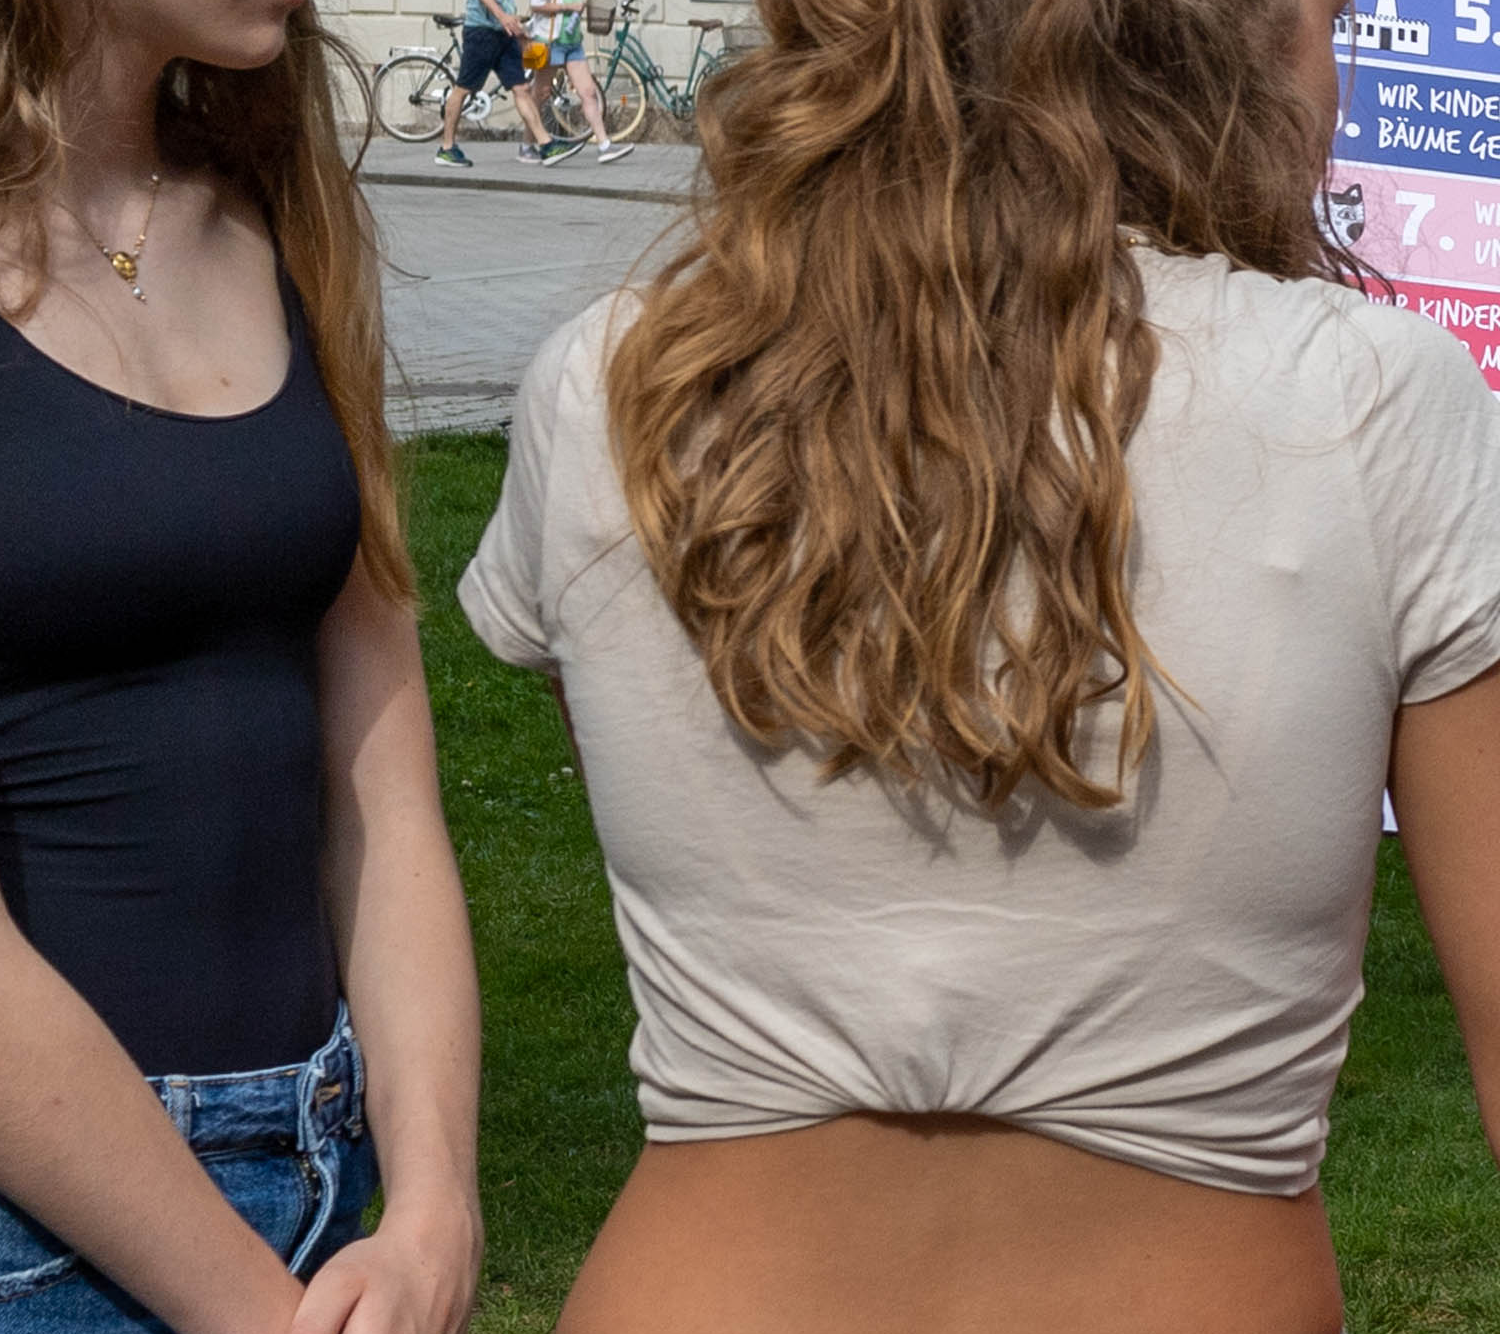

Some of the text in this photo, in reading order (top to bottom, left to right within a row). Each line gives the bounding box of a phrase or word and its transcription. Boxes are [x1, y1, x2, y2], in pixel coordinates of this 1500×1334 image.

[1378, 82, 1423, 111] WIR
[1377, 116, 1462, 155] BÄUME
[1395, 190, 1455, 251] 7.
